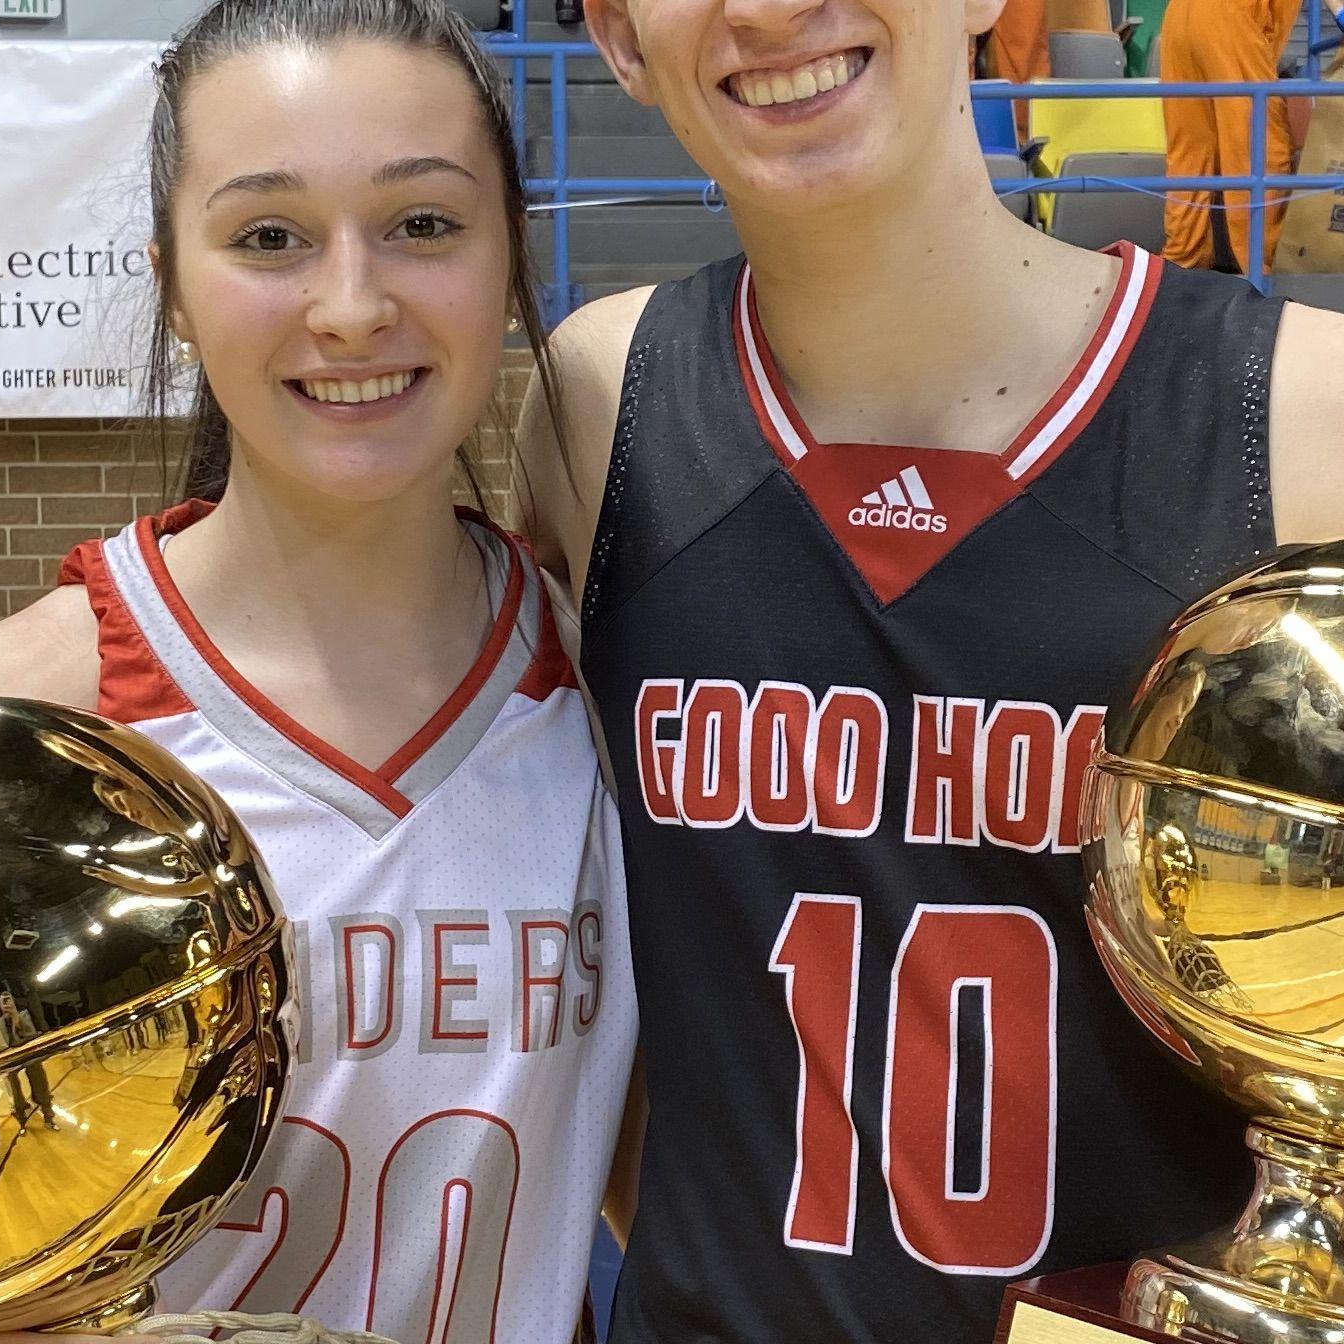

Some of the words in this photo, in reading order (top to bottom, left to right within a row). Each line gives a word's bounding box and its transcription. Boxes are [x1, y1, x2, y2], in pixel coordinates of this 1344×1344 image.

[847, 503, 949, 533] adidas
[634, 677, 889, 839] GOOD
[767, 891, 1059, 1277] 10
